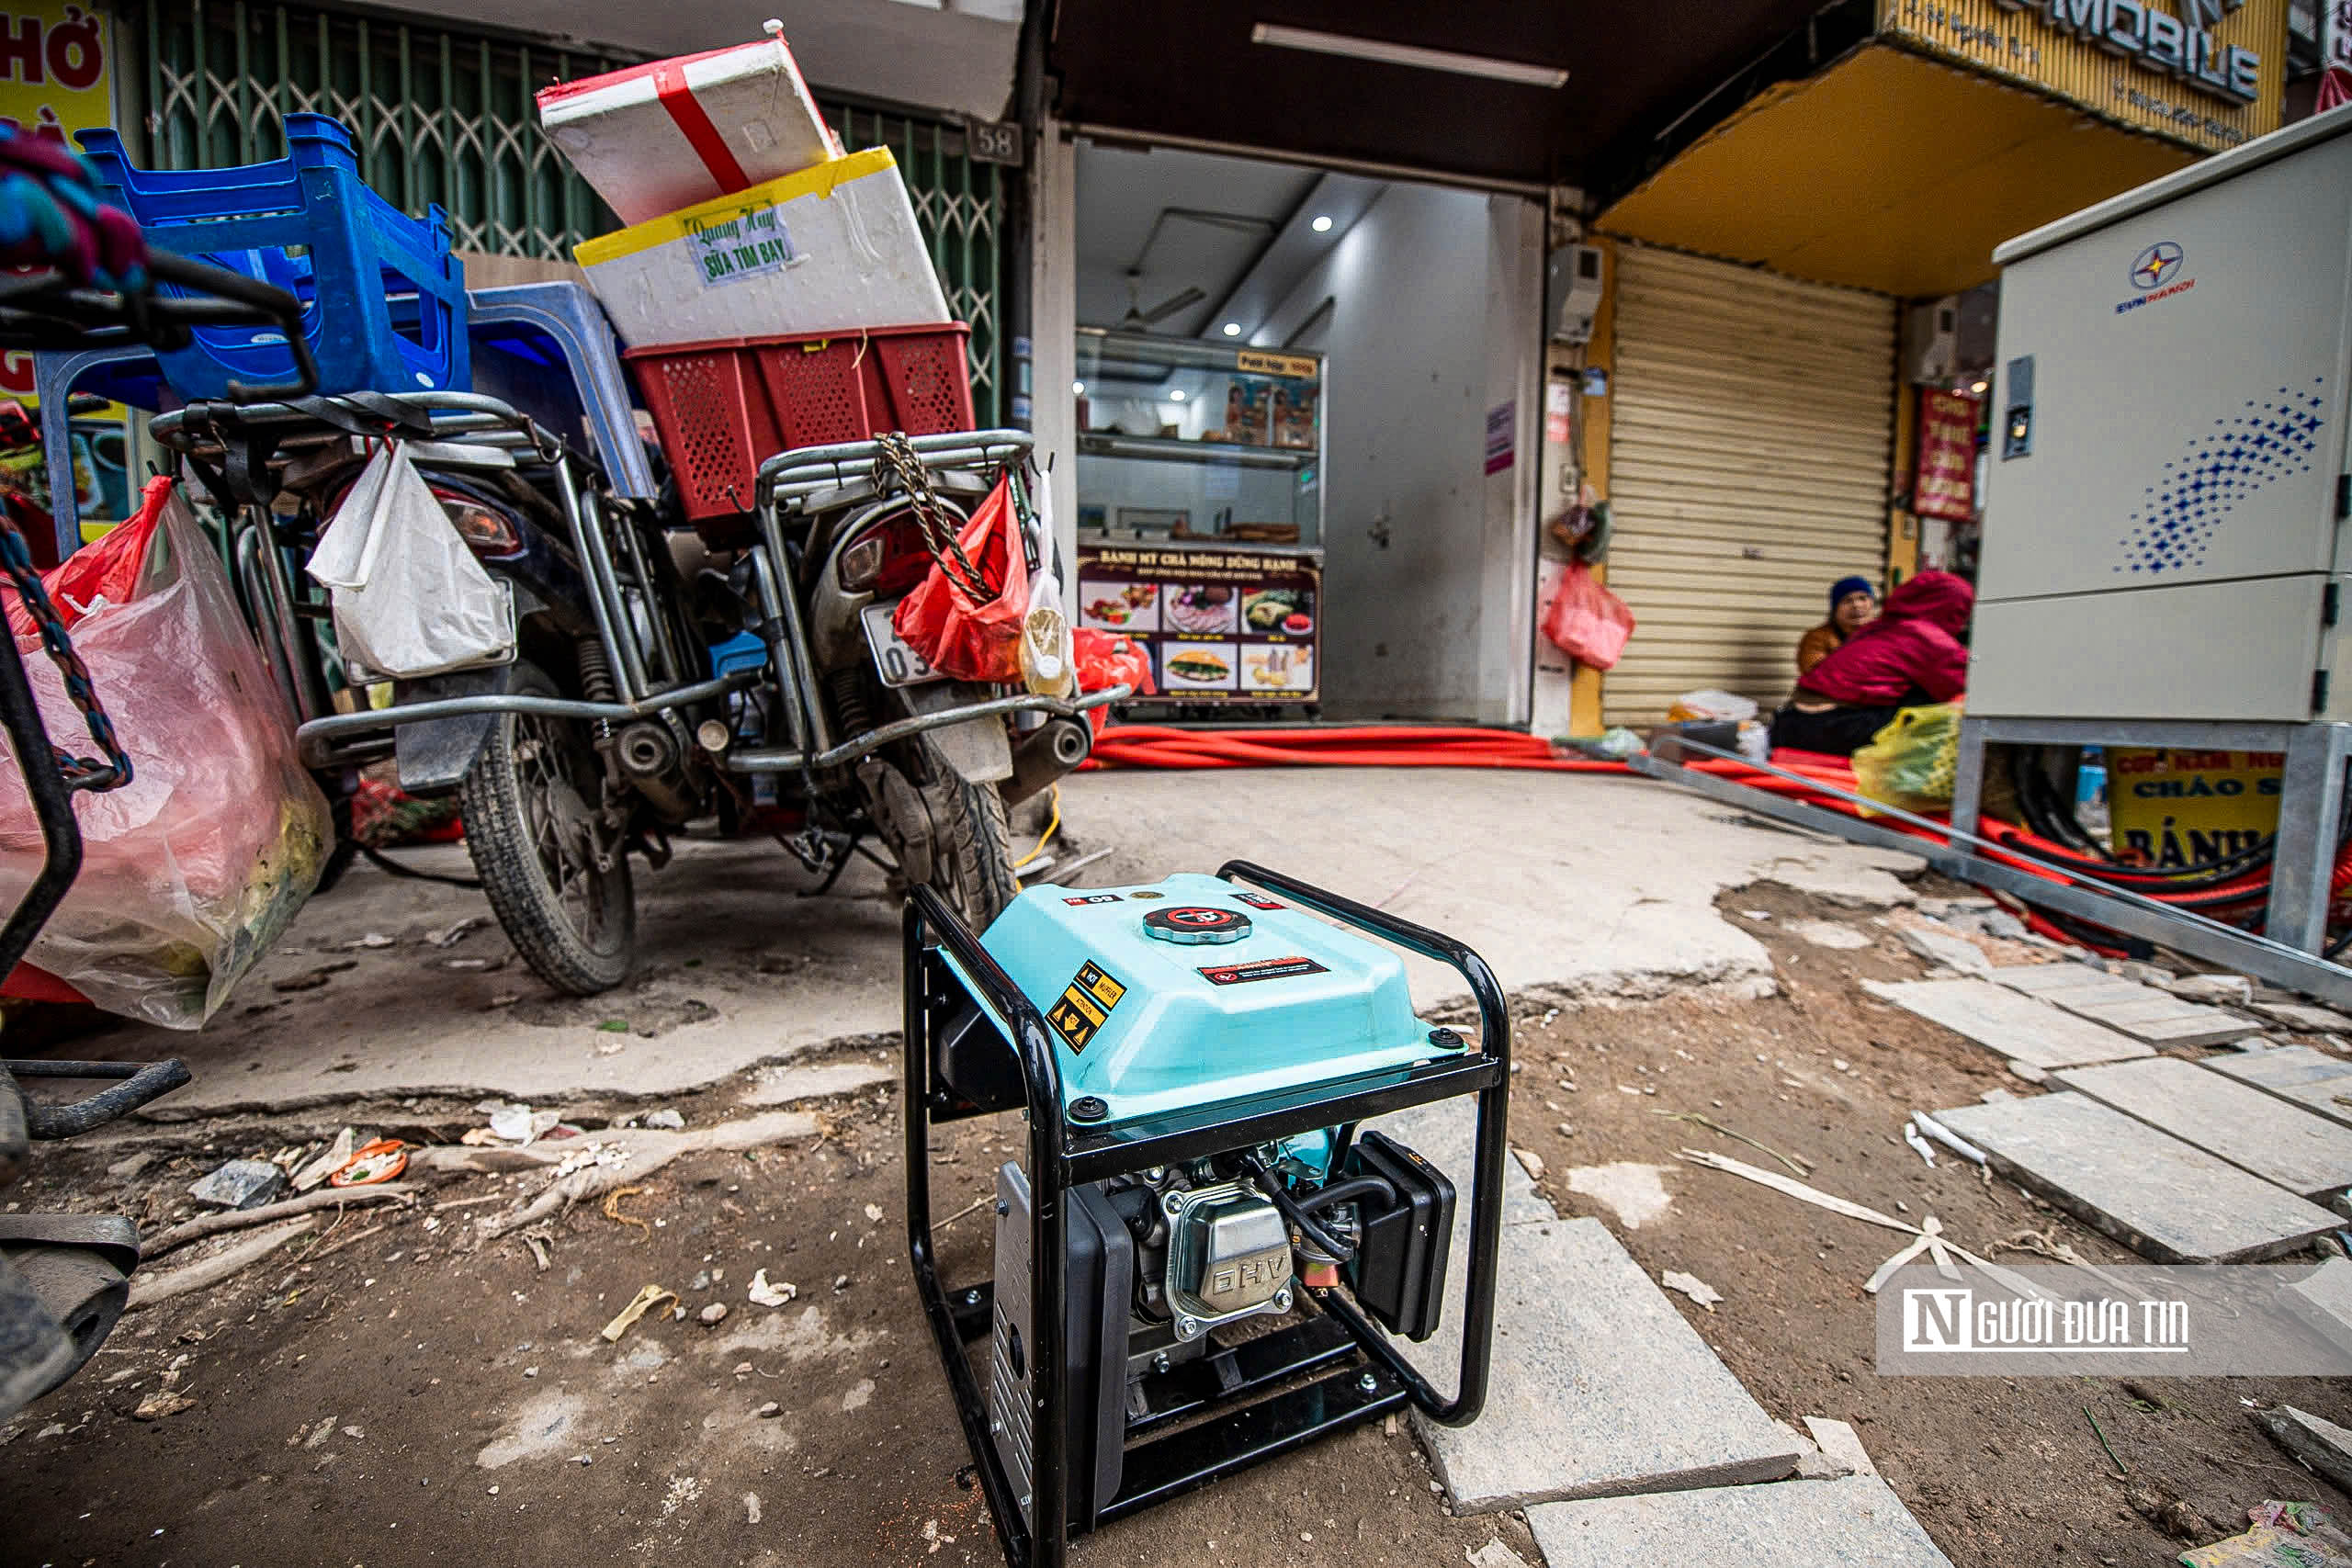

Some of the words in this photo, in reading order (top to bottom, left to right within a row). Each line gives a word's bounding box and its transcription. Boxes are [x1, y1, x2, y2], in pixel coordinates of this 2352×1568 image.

[978, 128, 1012, 154] 58
[2134, 775, 2245, 797] CHÁO
[1086, 972, 1099, 984] HOT
[1098, 981, 1117, 1000] MUFFLER
[1212, 1255, 1288, 1295] OHV
